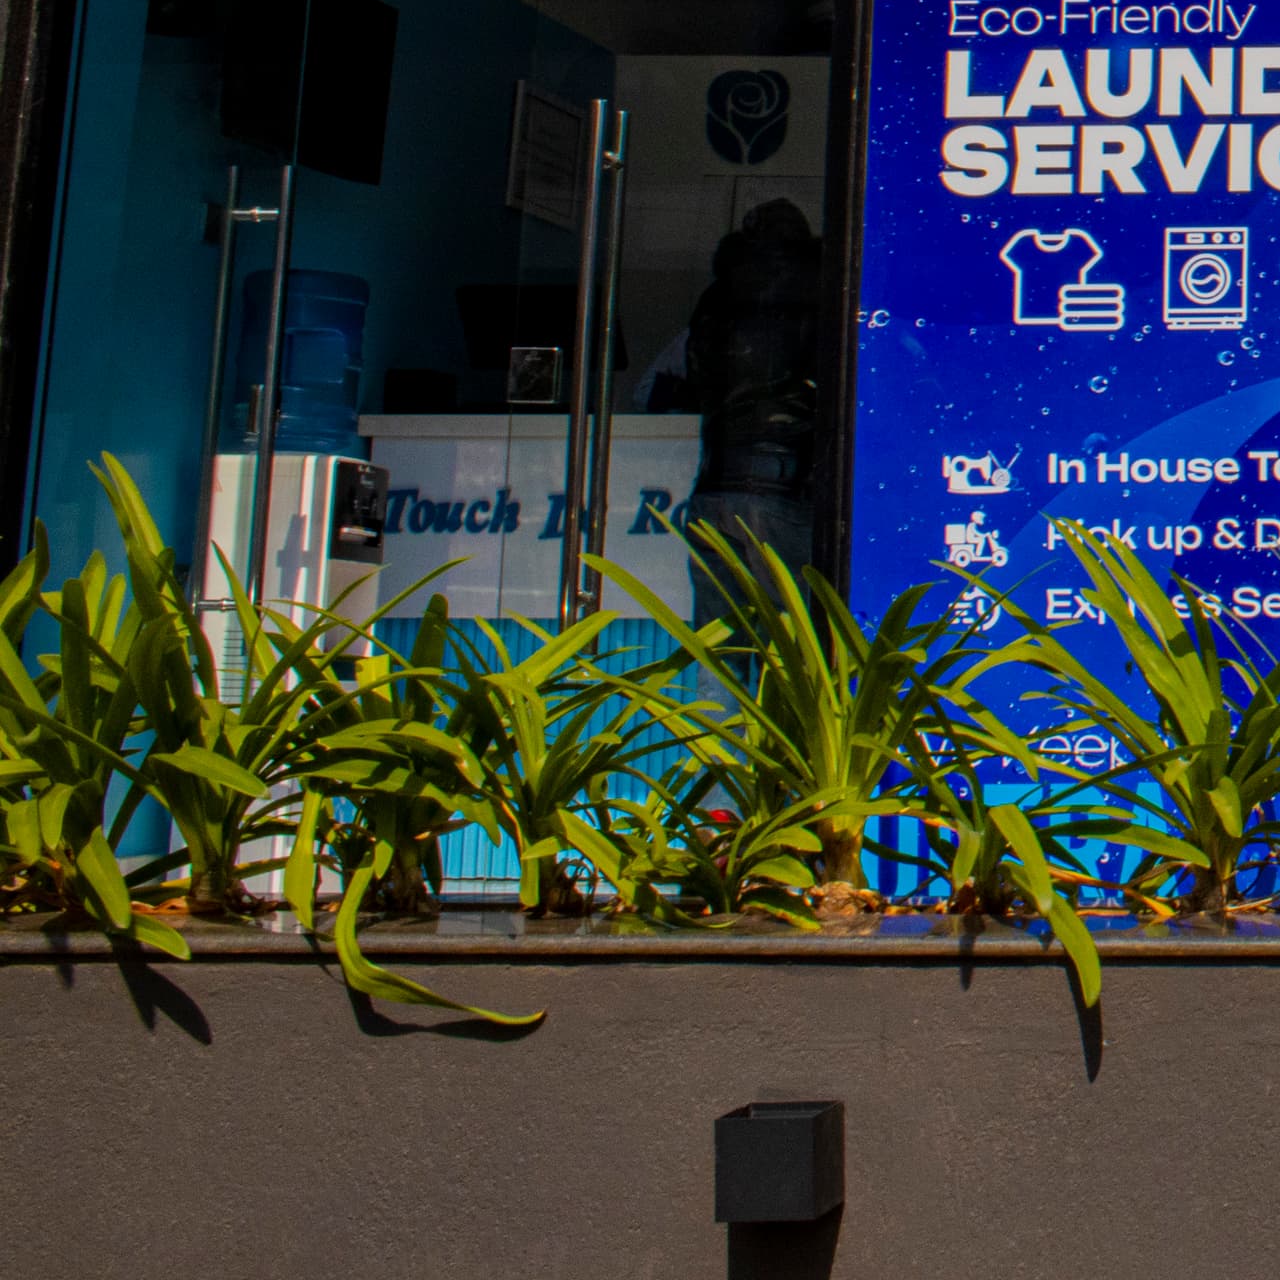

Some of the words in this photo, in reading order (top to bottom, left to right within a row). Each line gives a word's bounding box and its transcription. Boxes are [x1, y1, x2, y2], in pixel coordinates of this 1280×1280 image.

[1047, 453, 1086, 484] In
[1096, 452, 1240, 484] House
[383, 488, 521, 535] Touch
[1147, 524, 1203, 556] up
[1212, 518, 1246, 550] &
[1045, 587, 1223, 626] Exss
